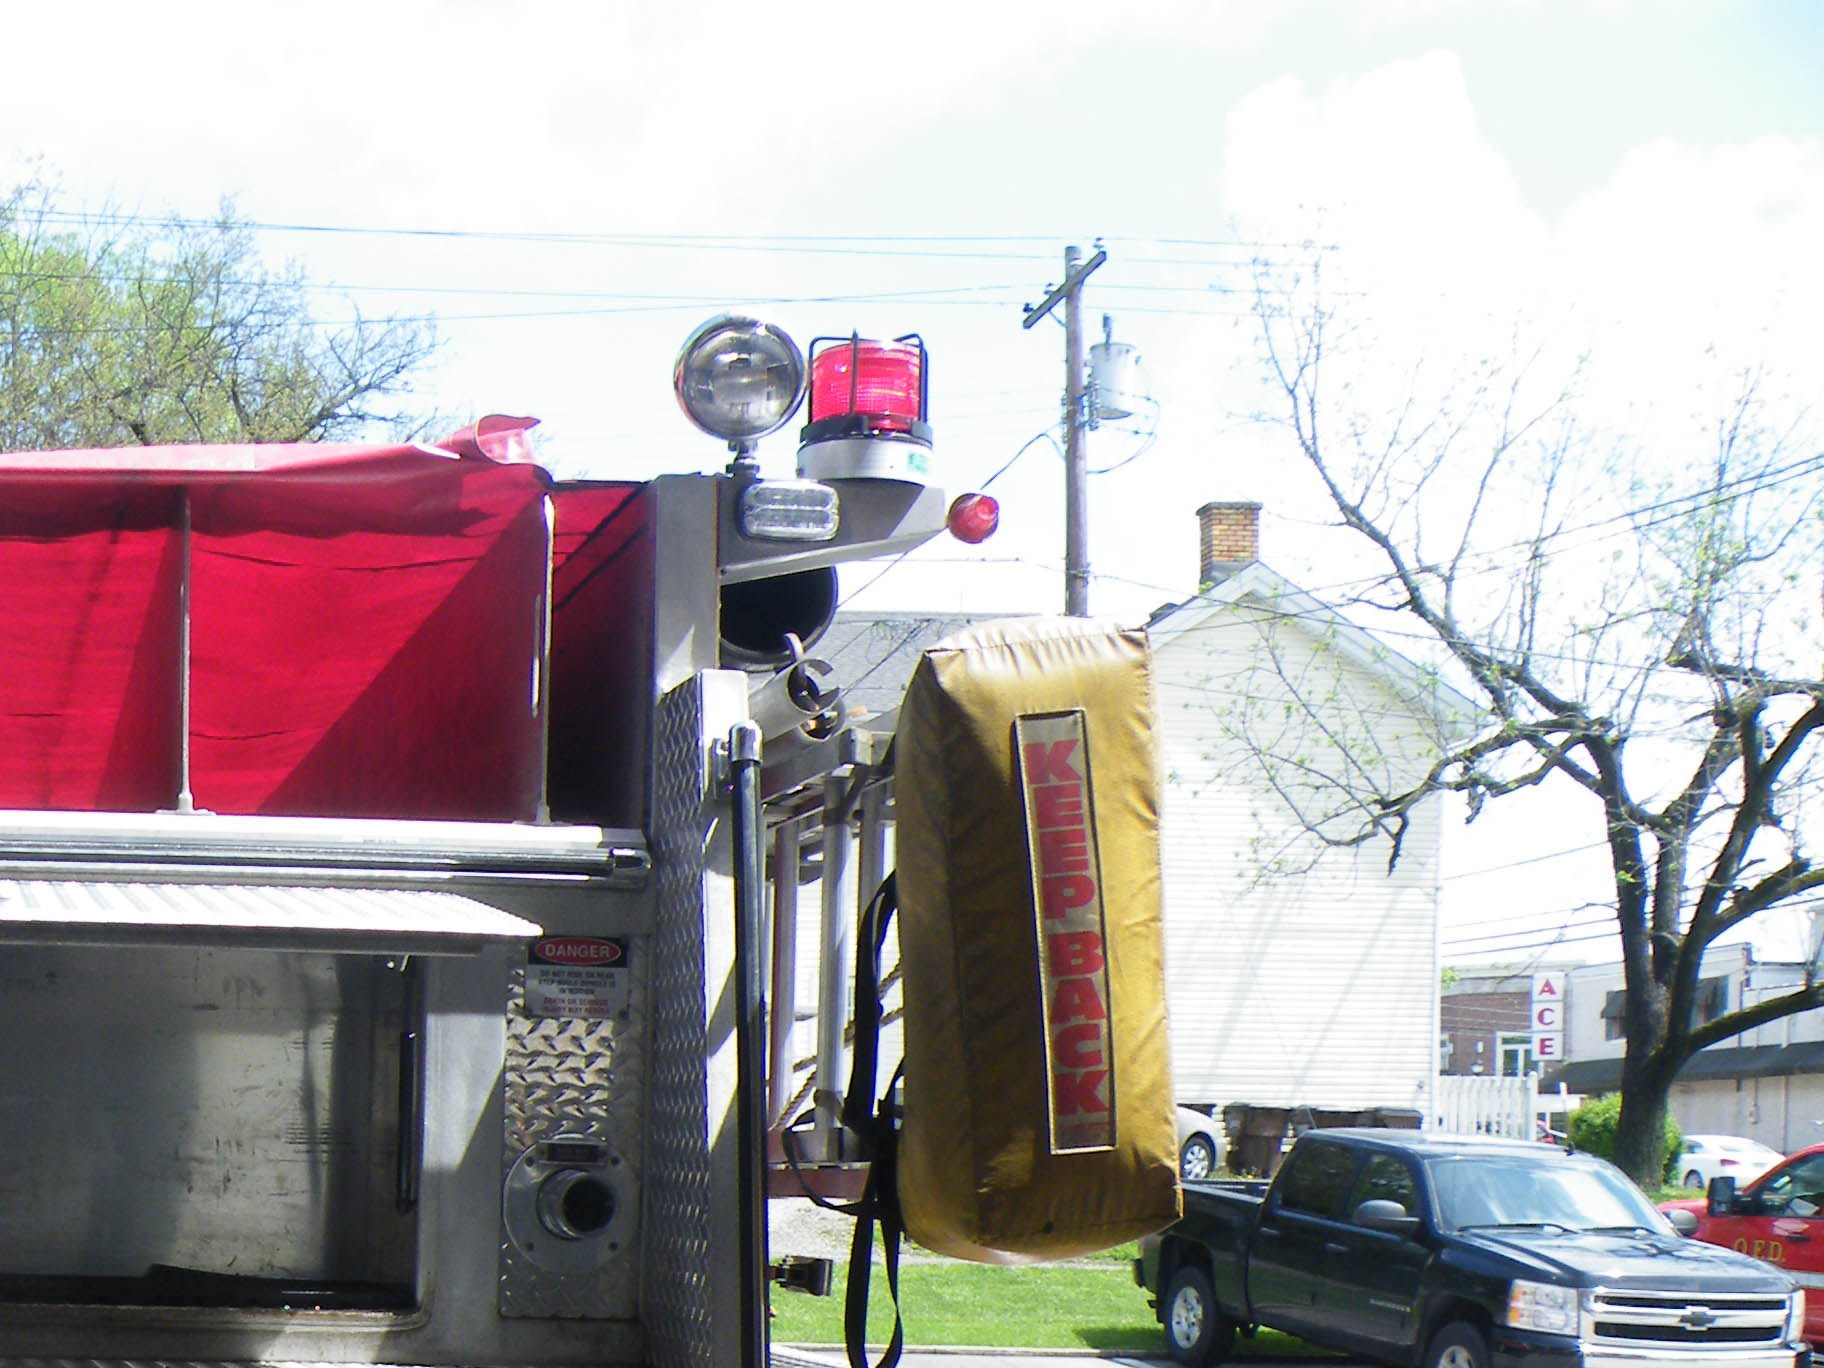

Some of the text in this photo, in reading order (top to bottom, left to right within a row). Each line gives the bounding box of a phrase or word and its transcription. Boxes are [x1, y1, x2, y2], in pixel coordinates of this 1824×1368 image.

[544, 943, 610, 958] DANGER
[1025, 738, 1109, 1116] KEEP BACK
[1537, 978, 1556, 1056] ACE
